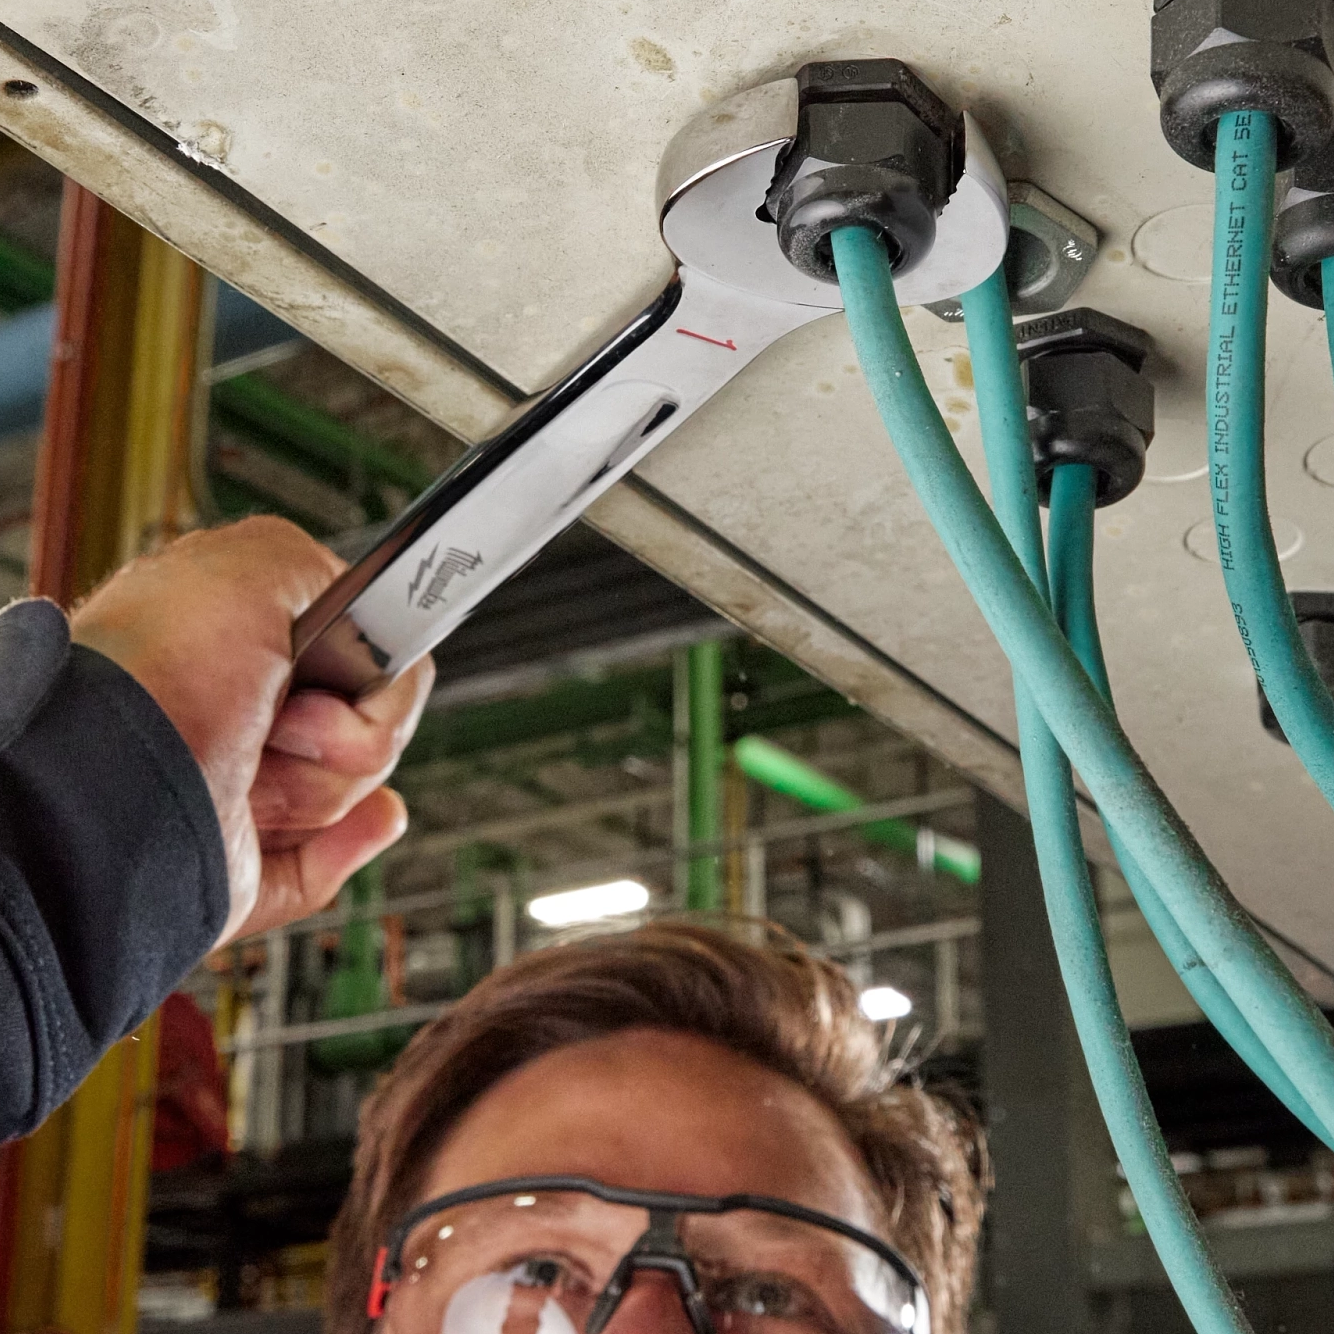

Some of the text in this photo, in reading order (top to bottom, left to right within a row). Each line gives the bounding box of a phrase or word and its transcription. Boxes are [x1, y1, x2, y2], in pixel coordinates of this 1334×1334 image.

[1231, 151, 1248, 191] CAT
[1222, 201, 1245, 315] ETHERNET
[1214, 325, 1235, 454] INDUSTRIAL
[1215, 463, 1229, 516] FLEX
[1218, 524, 1235, 571] HIGH
